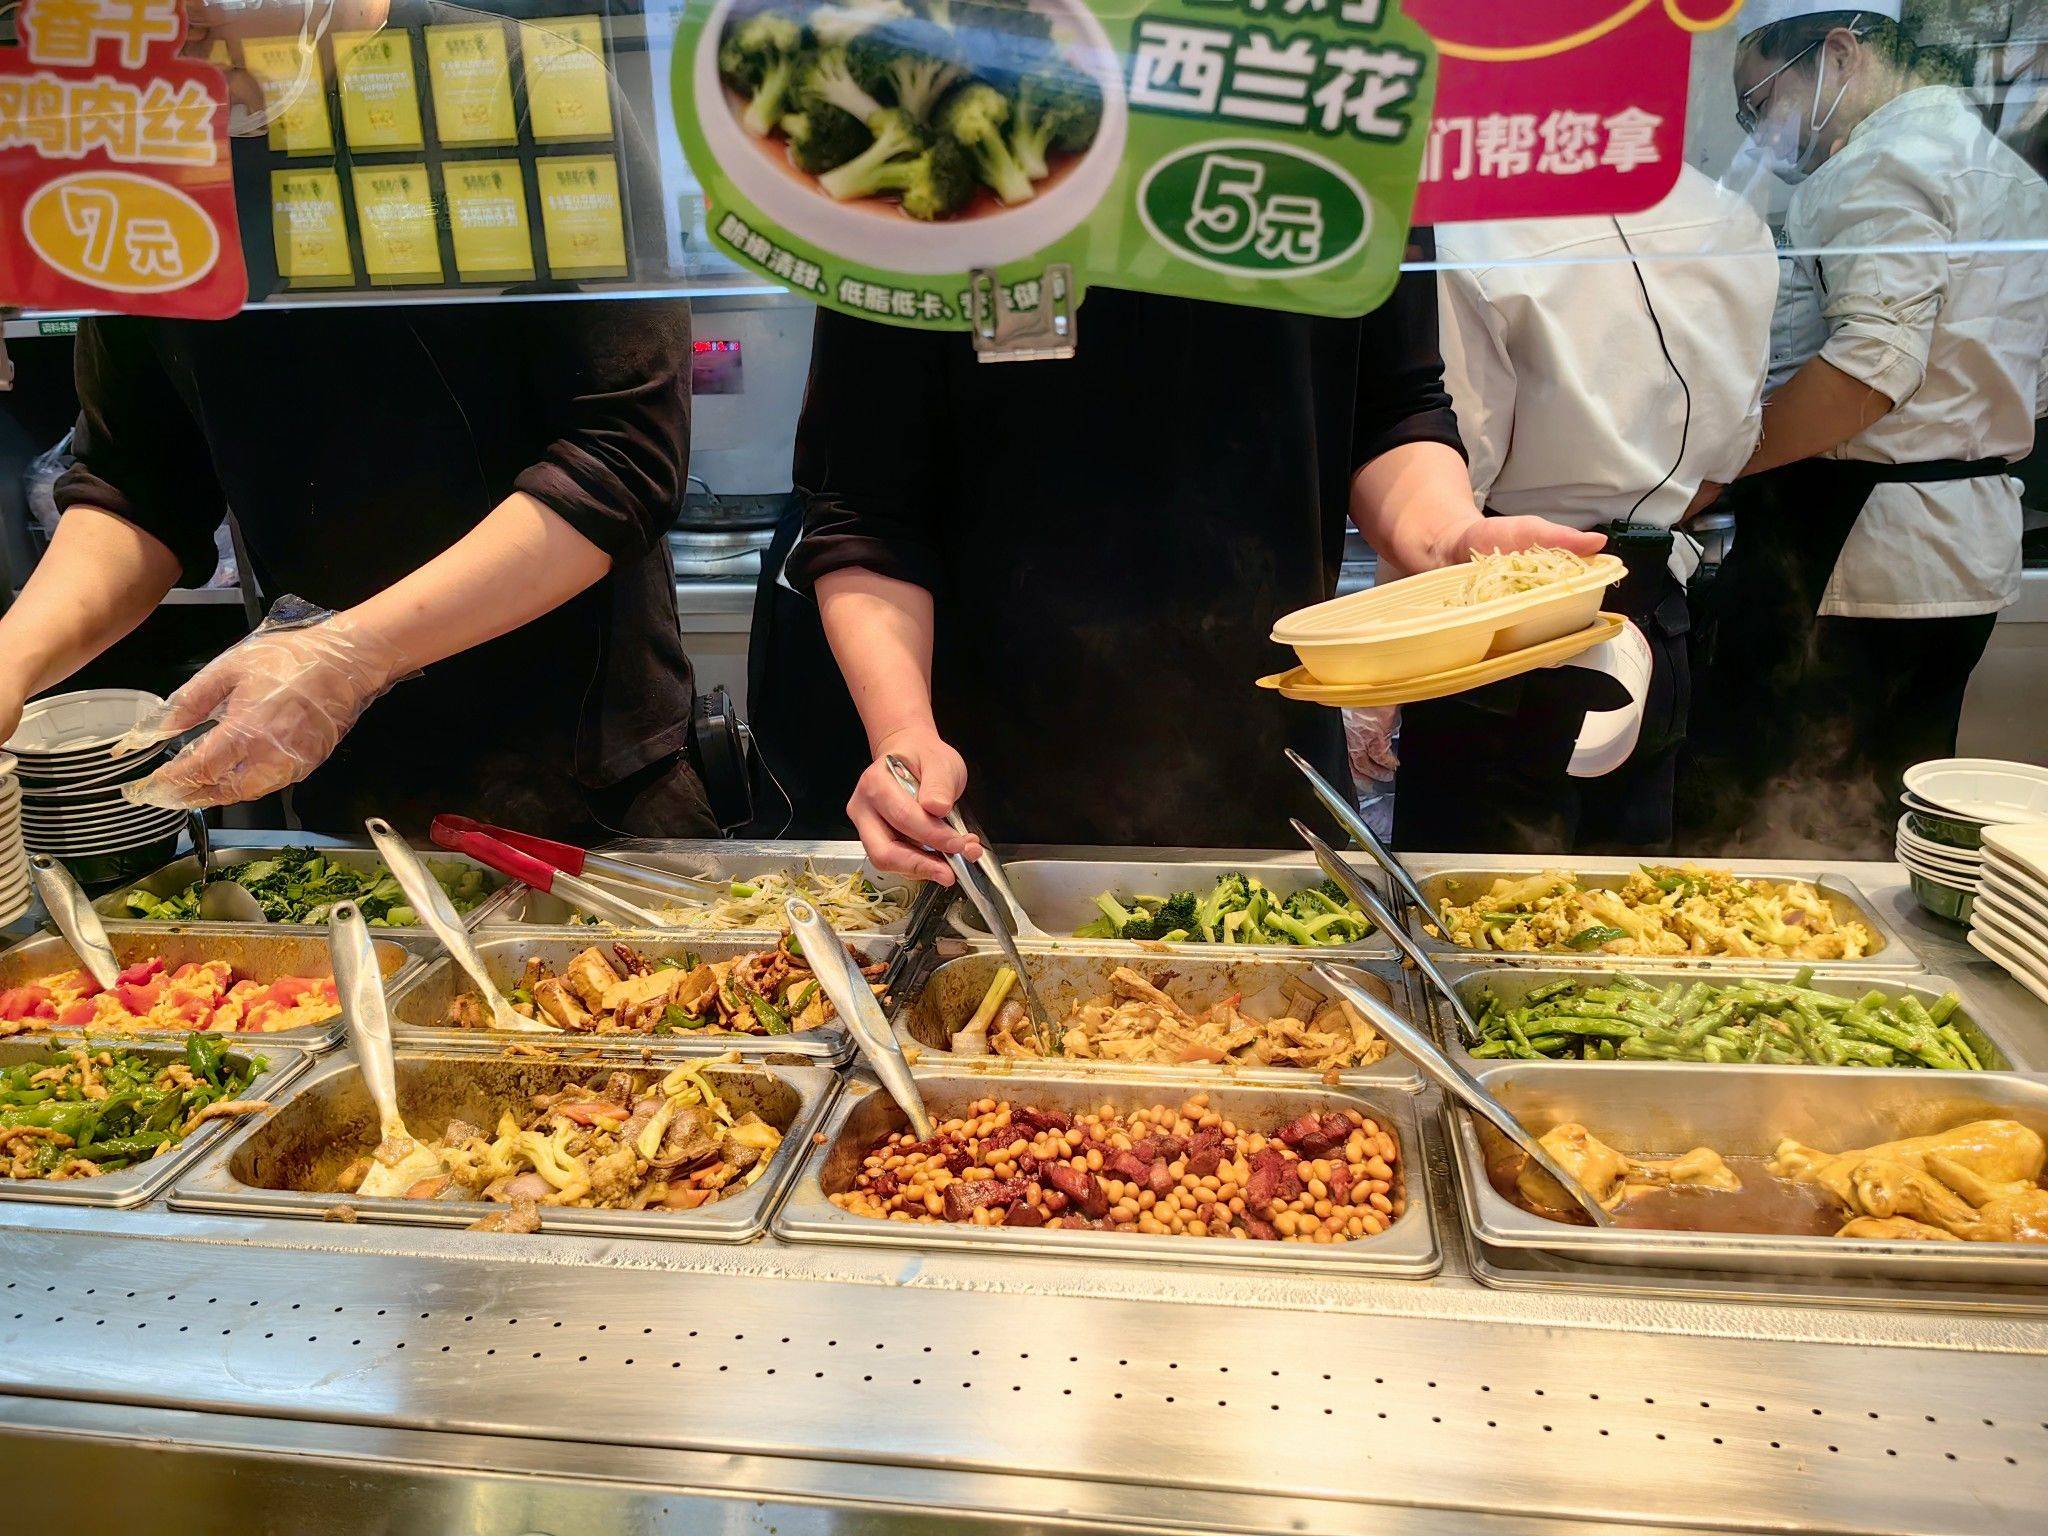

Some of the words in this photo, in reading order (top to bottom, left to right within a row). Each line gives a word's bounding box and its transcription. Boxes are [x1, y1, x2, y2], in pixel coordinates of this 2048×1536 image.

[0, 72, 217, 166] 鸡肉丝
[1129, 20, 1419, 138] 西兰花
[60, 185, 184, 277] 7元
[1184, 154, 1325, 265] 5元
